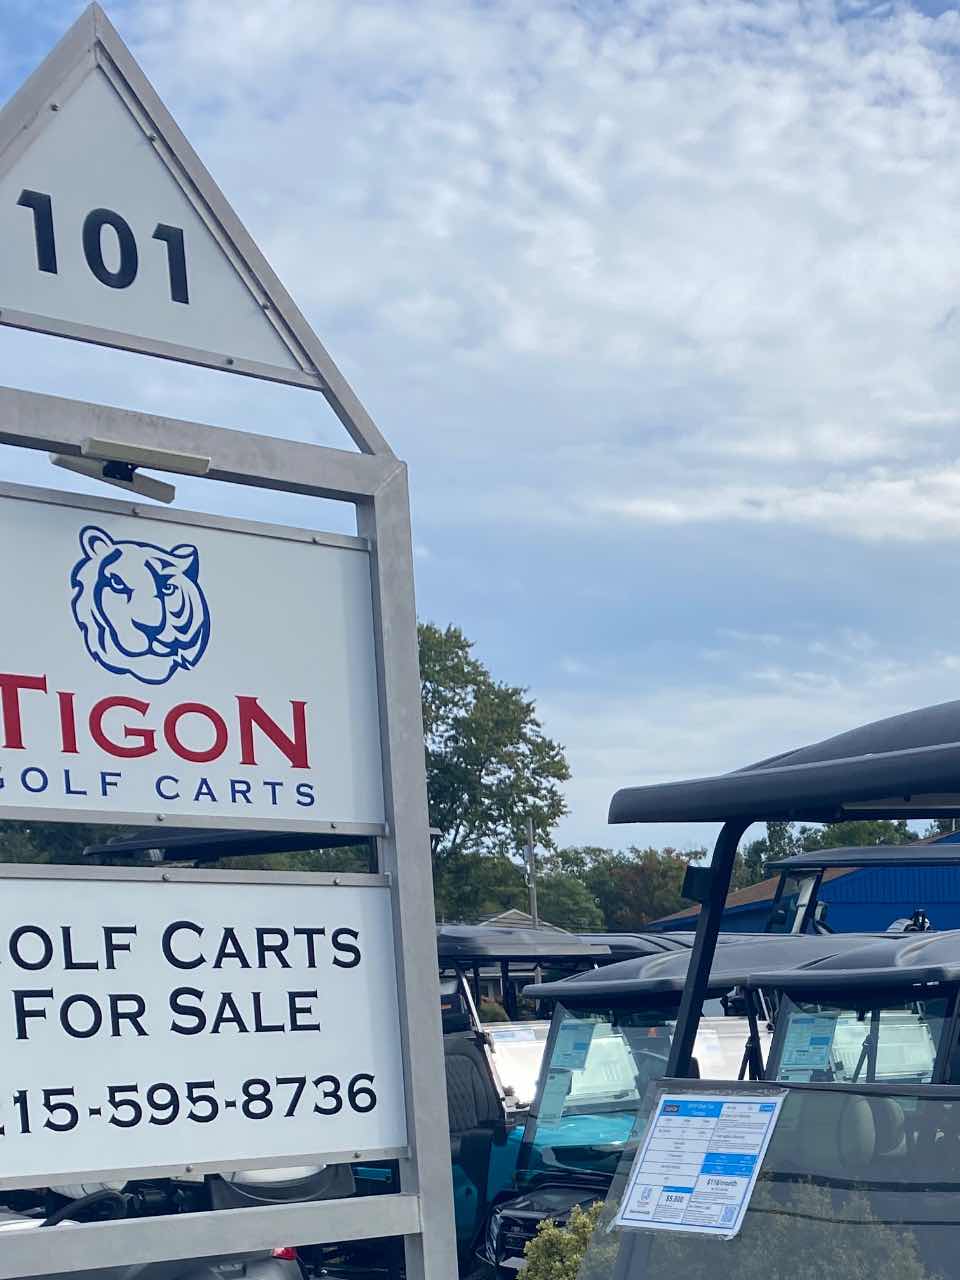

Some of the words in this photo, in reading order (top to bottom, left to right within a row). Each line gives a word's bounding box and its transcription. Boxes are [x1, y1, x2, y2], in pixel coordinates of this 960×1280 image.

[17, 188, 190, 305] 101
[0, 674, 309, 769] TIGON
[0, 767, 121, 796] OLF
[156, 775, 316, 807] CARTS
[0, 924, 137, 971] OLF
[0, 1073, 378, 1136] 15-595-8736
